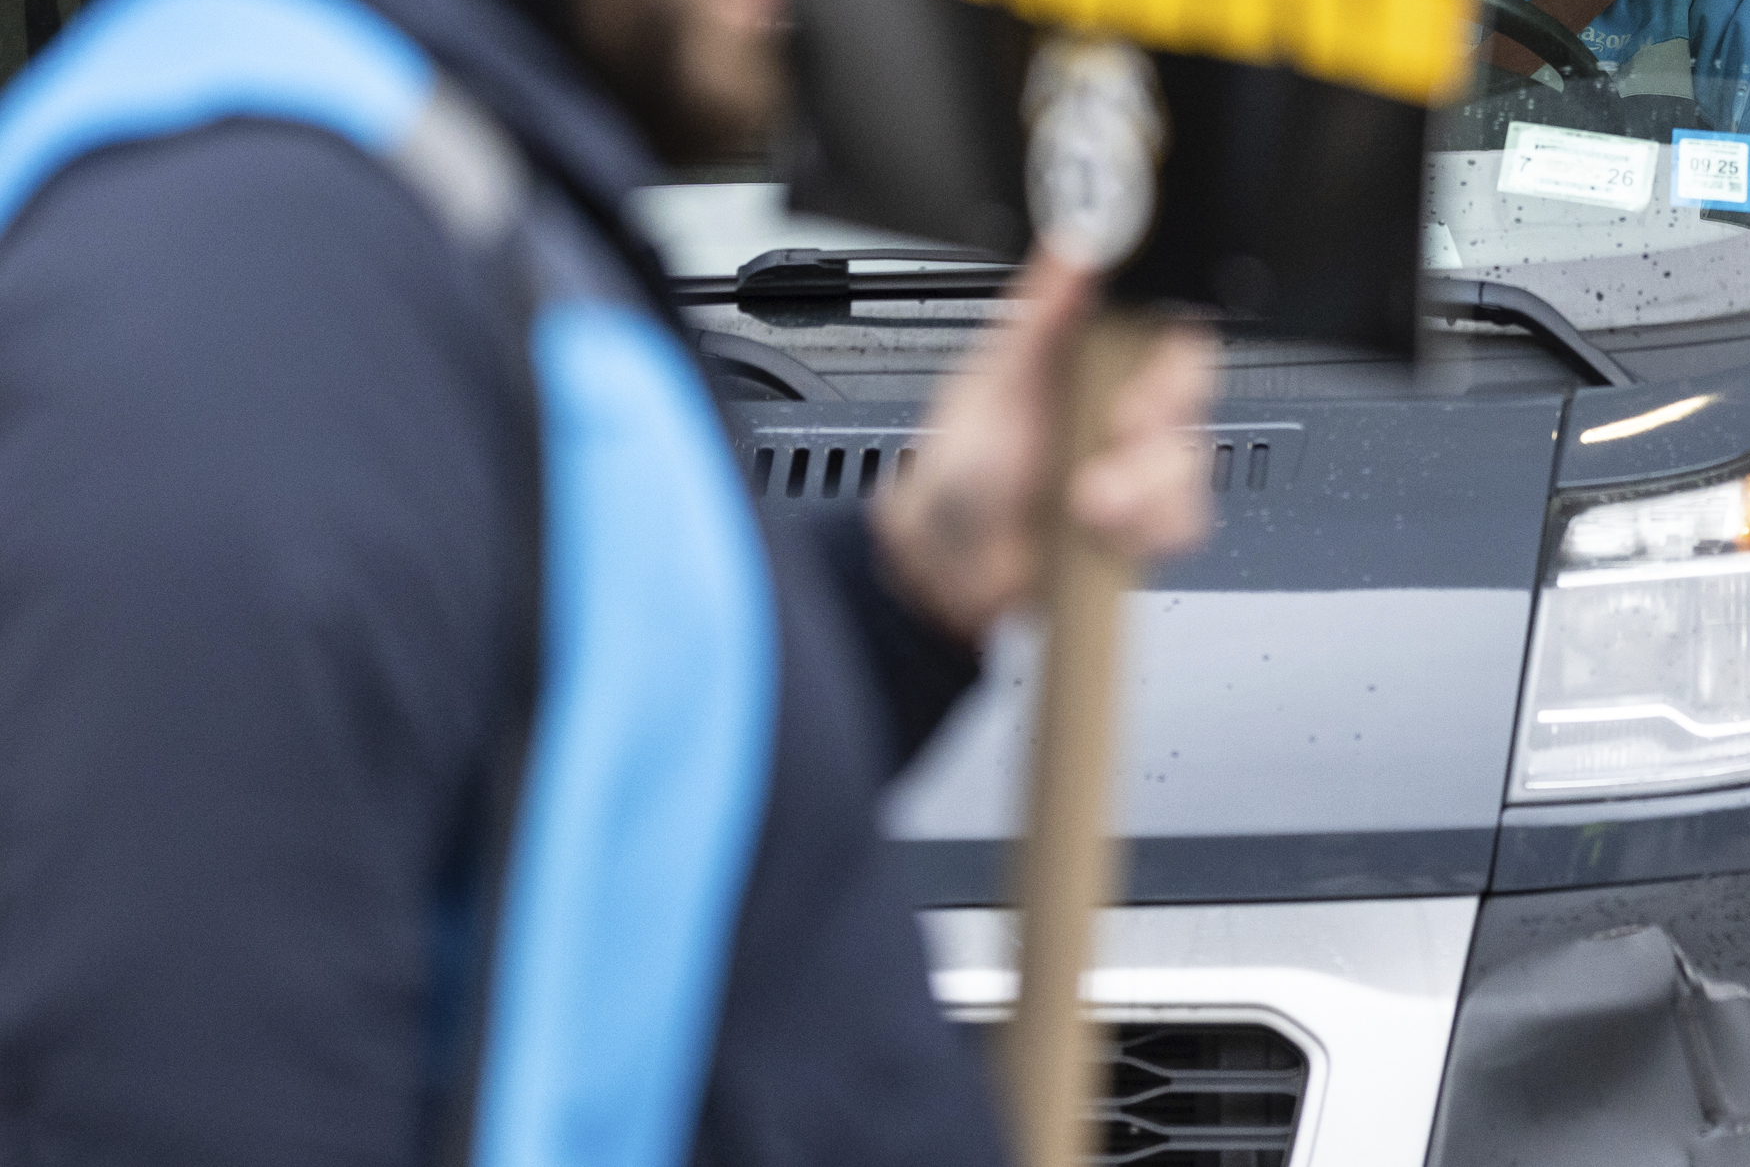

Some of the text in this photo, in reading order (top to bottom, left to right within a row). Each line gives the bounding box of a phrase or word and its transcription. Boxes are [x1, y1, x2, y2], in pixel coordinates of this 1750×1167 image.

[1576, 25, 1633, 50] azon
[1718, 159, 1739, 175] 25
[1607, 168, 1634, 187] 26
